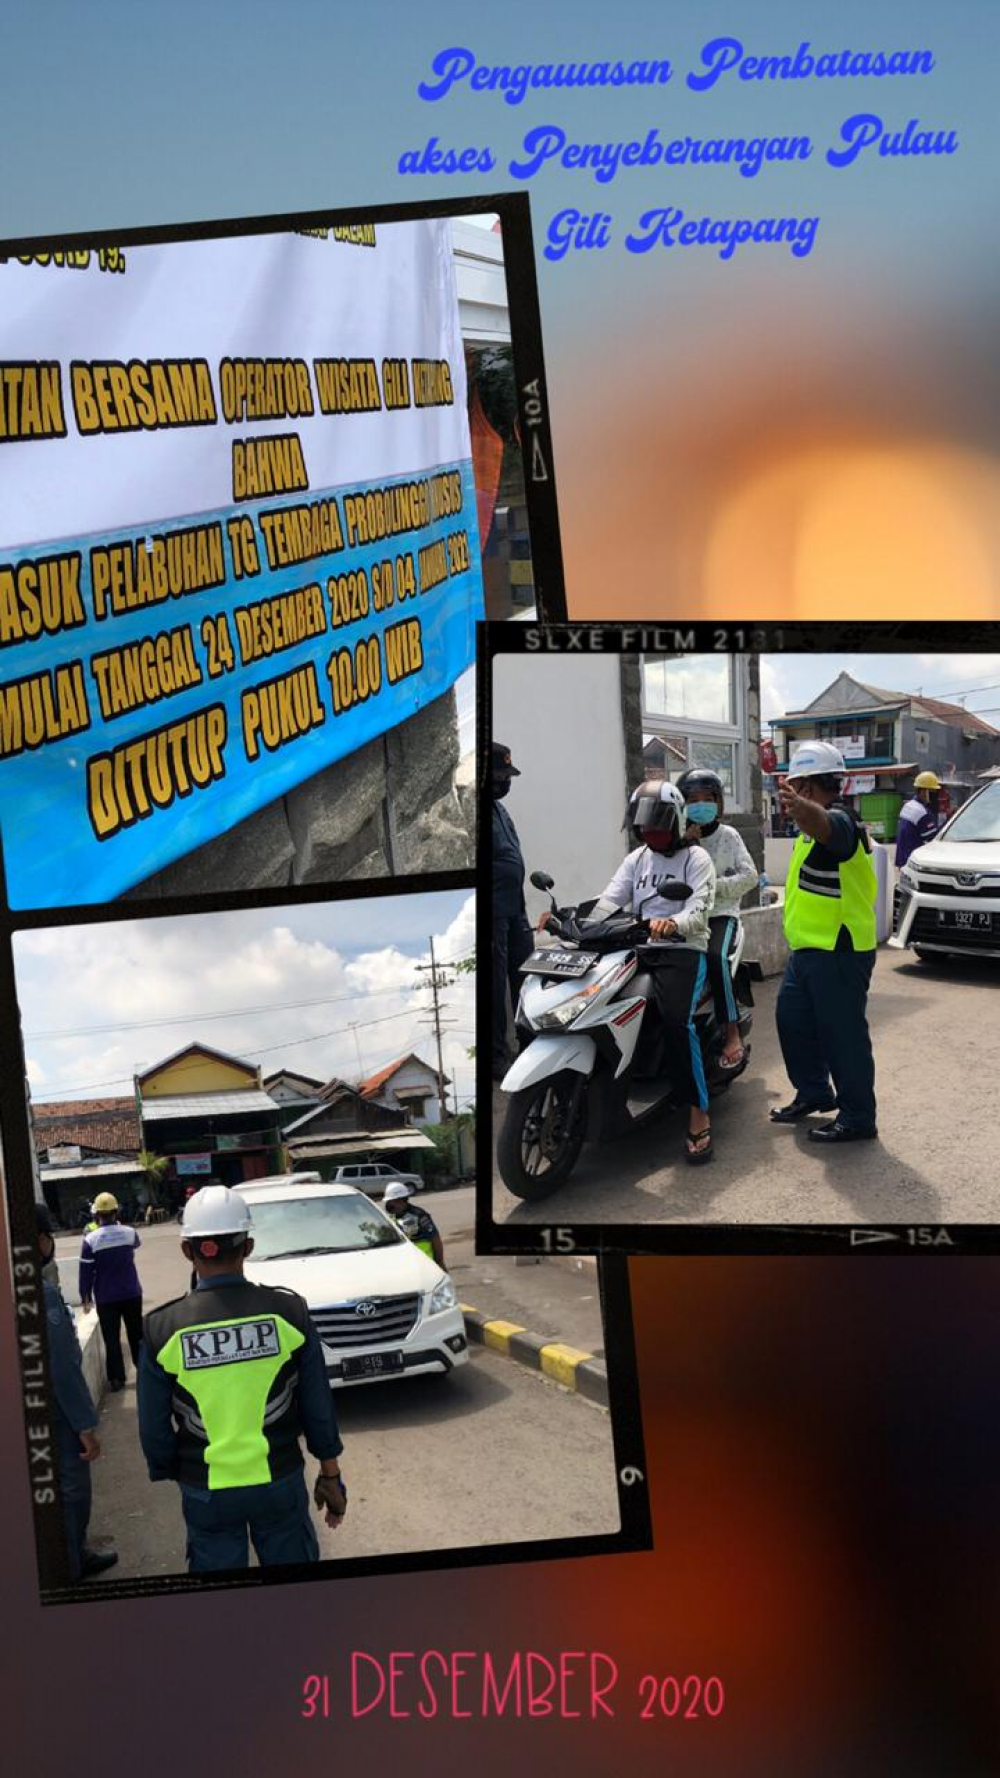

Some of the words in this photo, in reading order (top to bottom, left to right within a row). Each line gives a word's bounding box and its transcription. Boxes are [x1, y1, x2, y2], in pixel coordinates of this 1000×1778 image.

[70, 357, 218, 437] BERSAMA
[219, 356, 315, 425] OPERATOR
[313, 356, 382, 415] WISATA
[382, 357, 411, 411] GILI
[232, 431, 309, 503] BAHWA
[0, 550, 87, 649] ASUK
[90, 521, 226, 622] PELABUHAN
[227, 514, 261, 580] TG
[258, 497, 345, 570] TEMBAGA
[0, 659, 91, 760] MULAI
[90, 622, 203, 722] TANGGAL
[201, 611, 236, 679] 24
[234, 582, 327, 666] DESEMBER
[327, 566, 369, 629] 2020
[396, 552, 416, 602] 04
[87, 702, 227, 842] DITUTUP
[242, 661, 325, 762] PUKUL
[327, 634, 382, 716] 10.00
[384, 616, 423, 685] WIB
[636, 873, 676, 890] HU
[183, 1323, 275, 1360] KPLP
